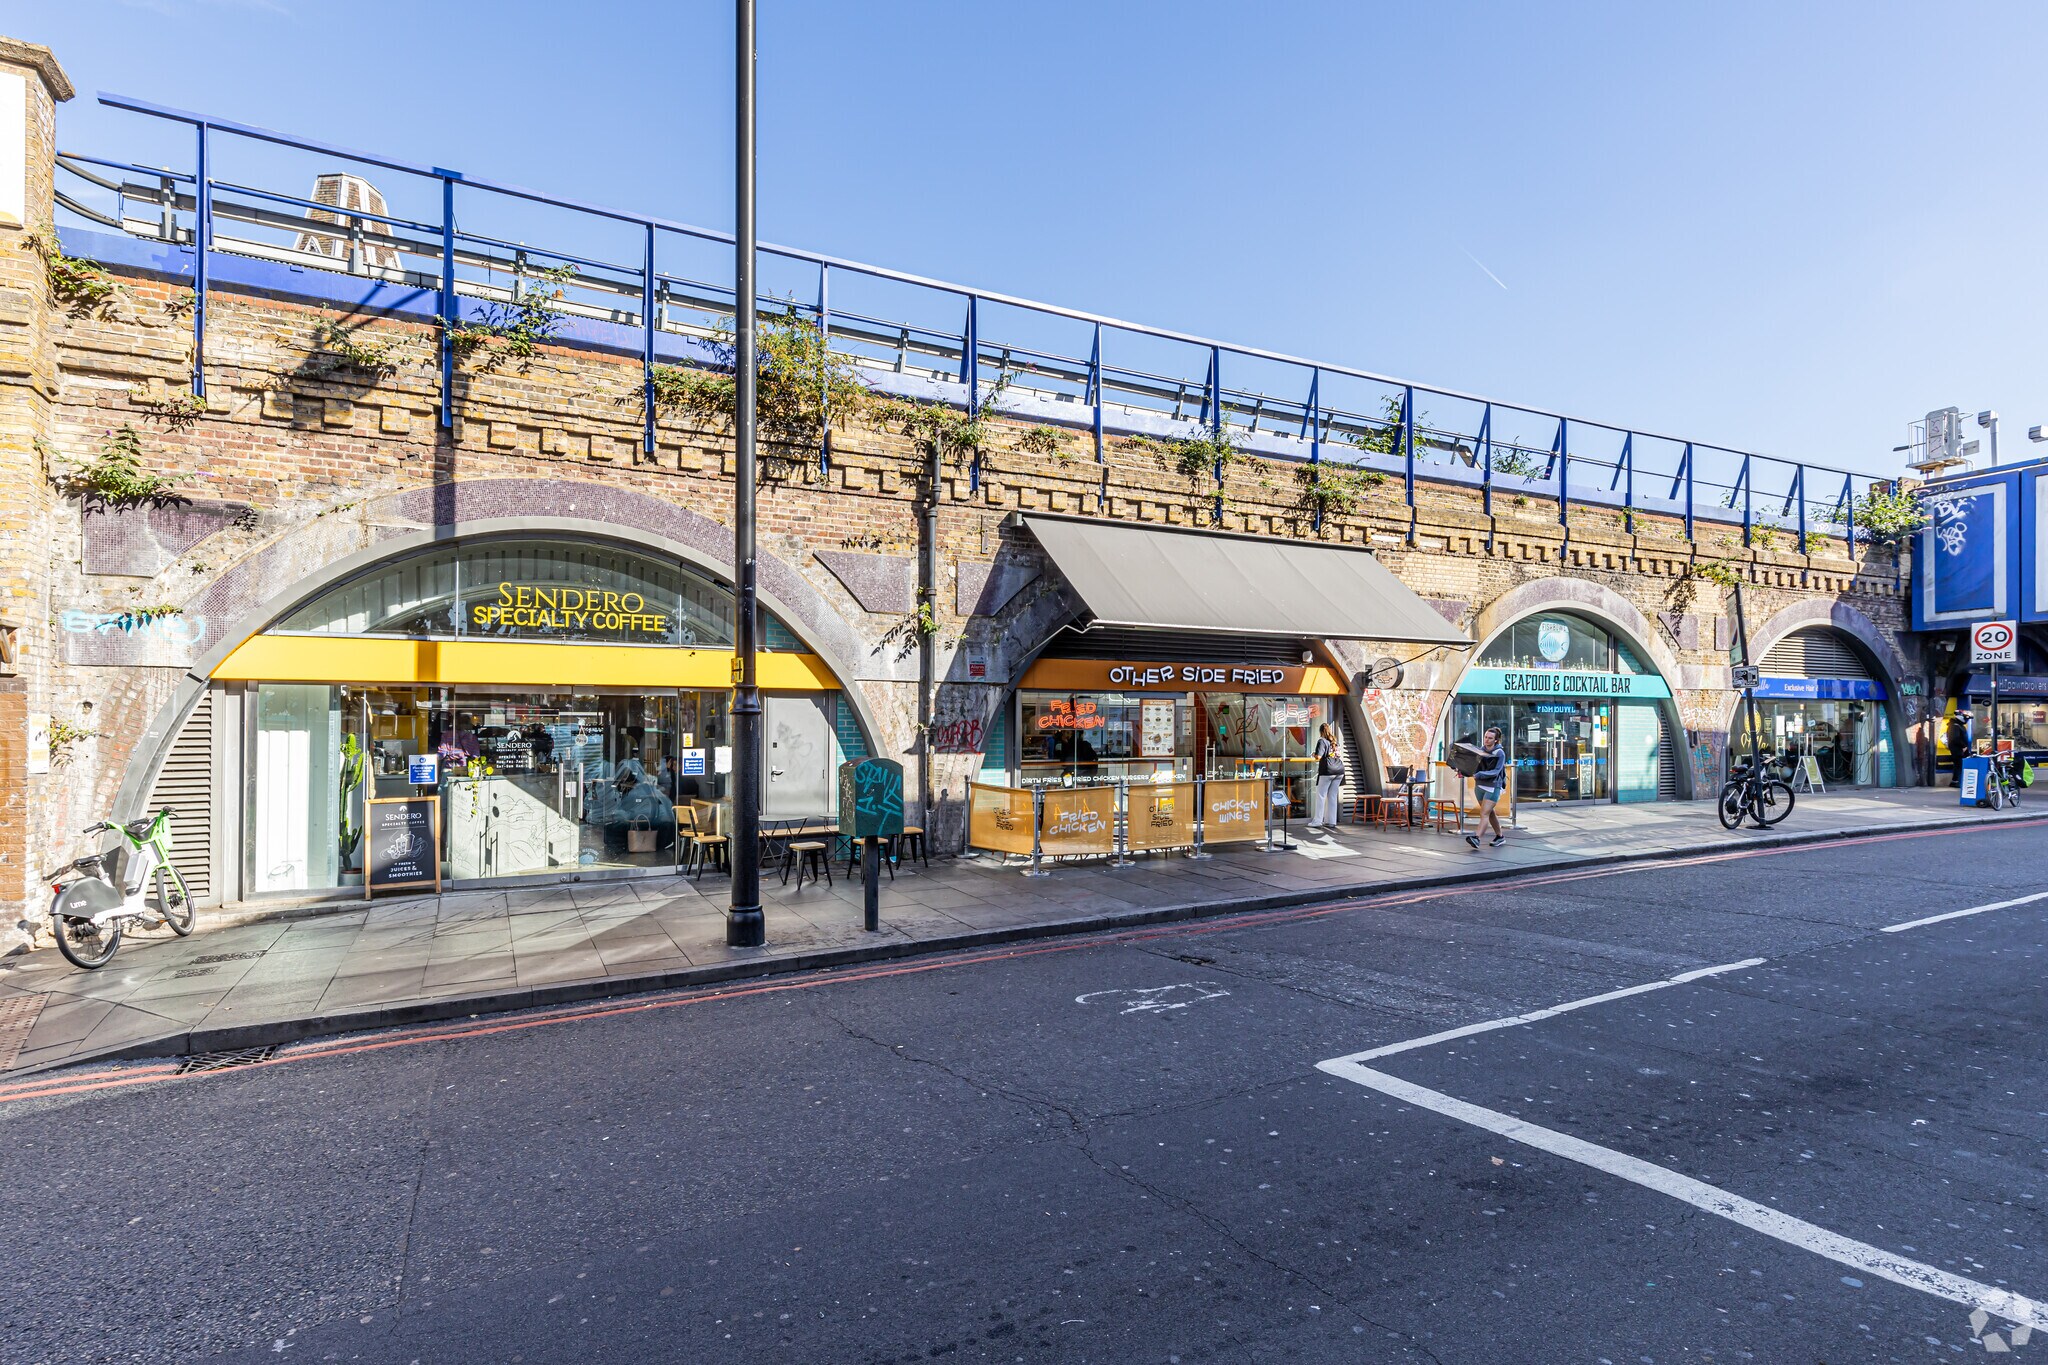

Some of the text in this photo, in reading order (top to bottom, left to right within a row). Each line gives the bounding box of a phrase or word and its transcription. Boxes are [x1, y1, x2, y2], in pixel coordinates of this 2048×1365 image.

[498, 581, 645, 613] SENDERO
[473, 605, 666, 632] SPECIALTY COFFEE
[1981, 631, 2007, 643] 20
[1976, 651, 2011, 660] ZONE
[1109, 665, 1175, 687] OTHER
[1231, 668, 1284, 685] FRIED
[1504, 673, 1631, 693] SEAFOOD & COCKTAIL BAR
[1784, 683, 1804, 692] Exclusive
[1805, 684, 1815, 692] Hair
[1038, 714, 1105, 729] CHICKEN
[1212, 799, 1258, 812] CHICKEN
[385, 812, 422, 821] SENDERO
[1060, 810, 1098, 822] FRIED
[1219, 811, 1250, 823] WINGS
[996, 822, 1014, 831] FRIED
[1050, 820, 1106, 834] CHICKEN
